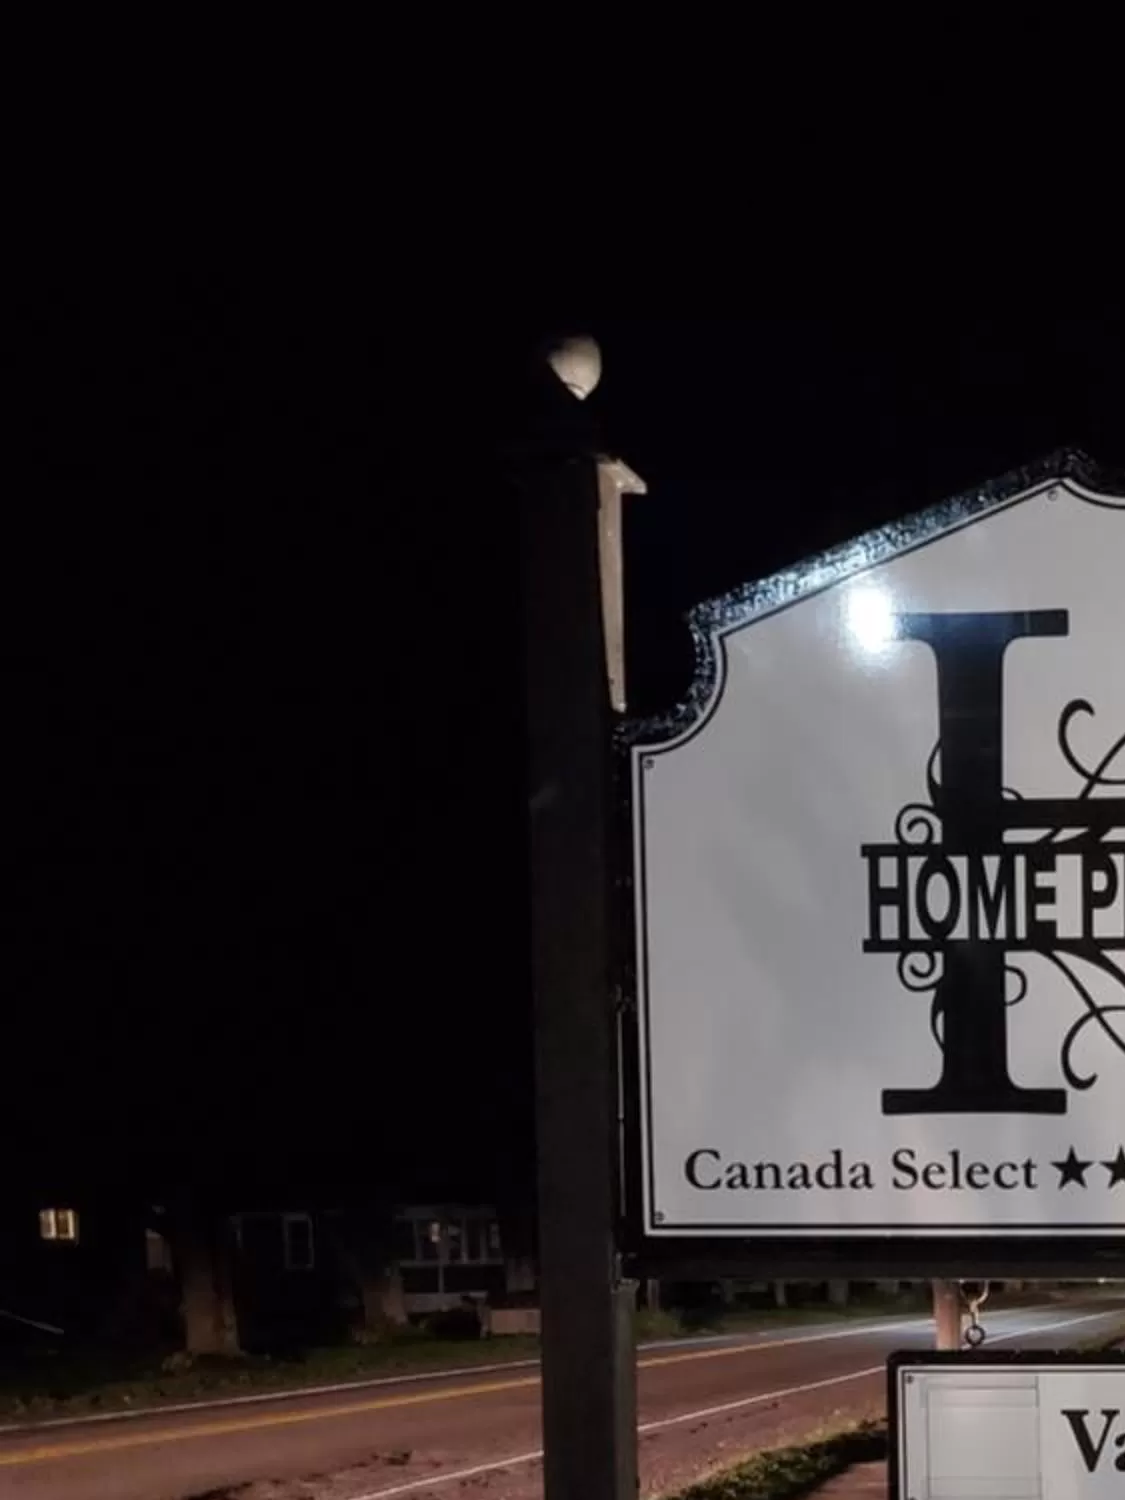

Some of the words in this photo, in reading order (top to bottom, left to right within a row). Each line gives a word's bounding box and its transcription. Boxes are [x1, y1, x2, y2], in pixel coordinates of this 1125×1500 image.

[865, 848, 1057, 944] HOME
[684, 1148, 874, 1191] Canada
[891, 1148, 1039, 1191] Select
